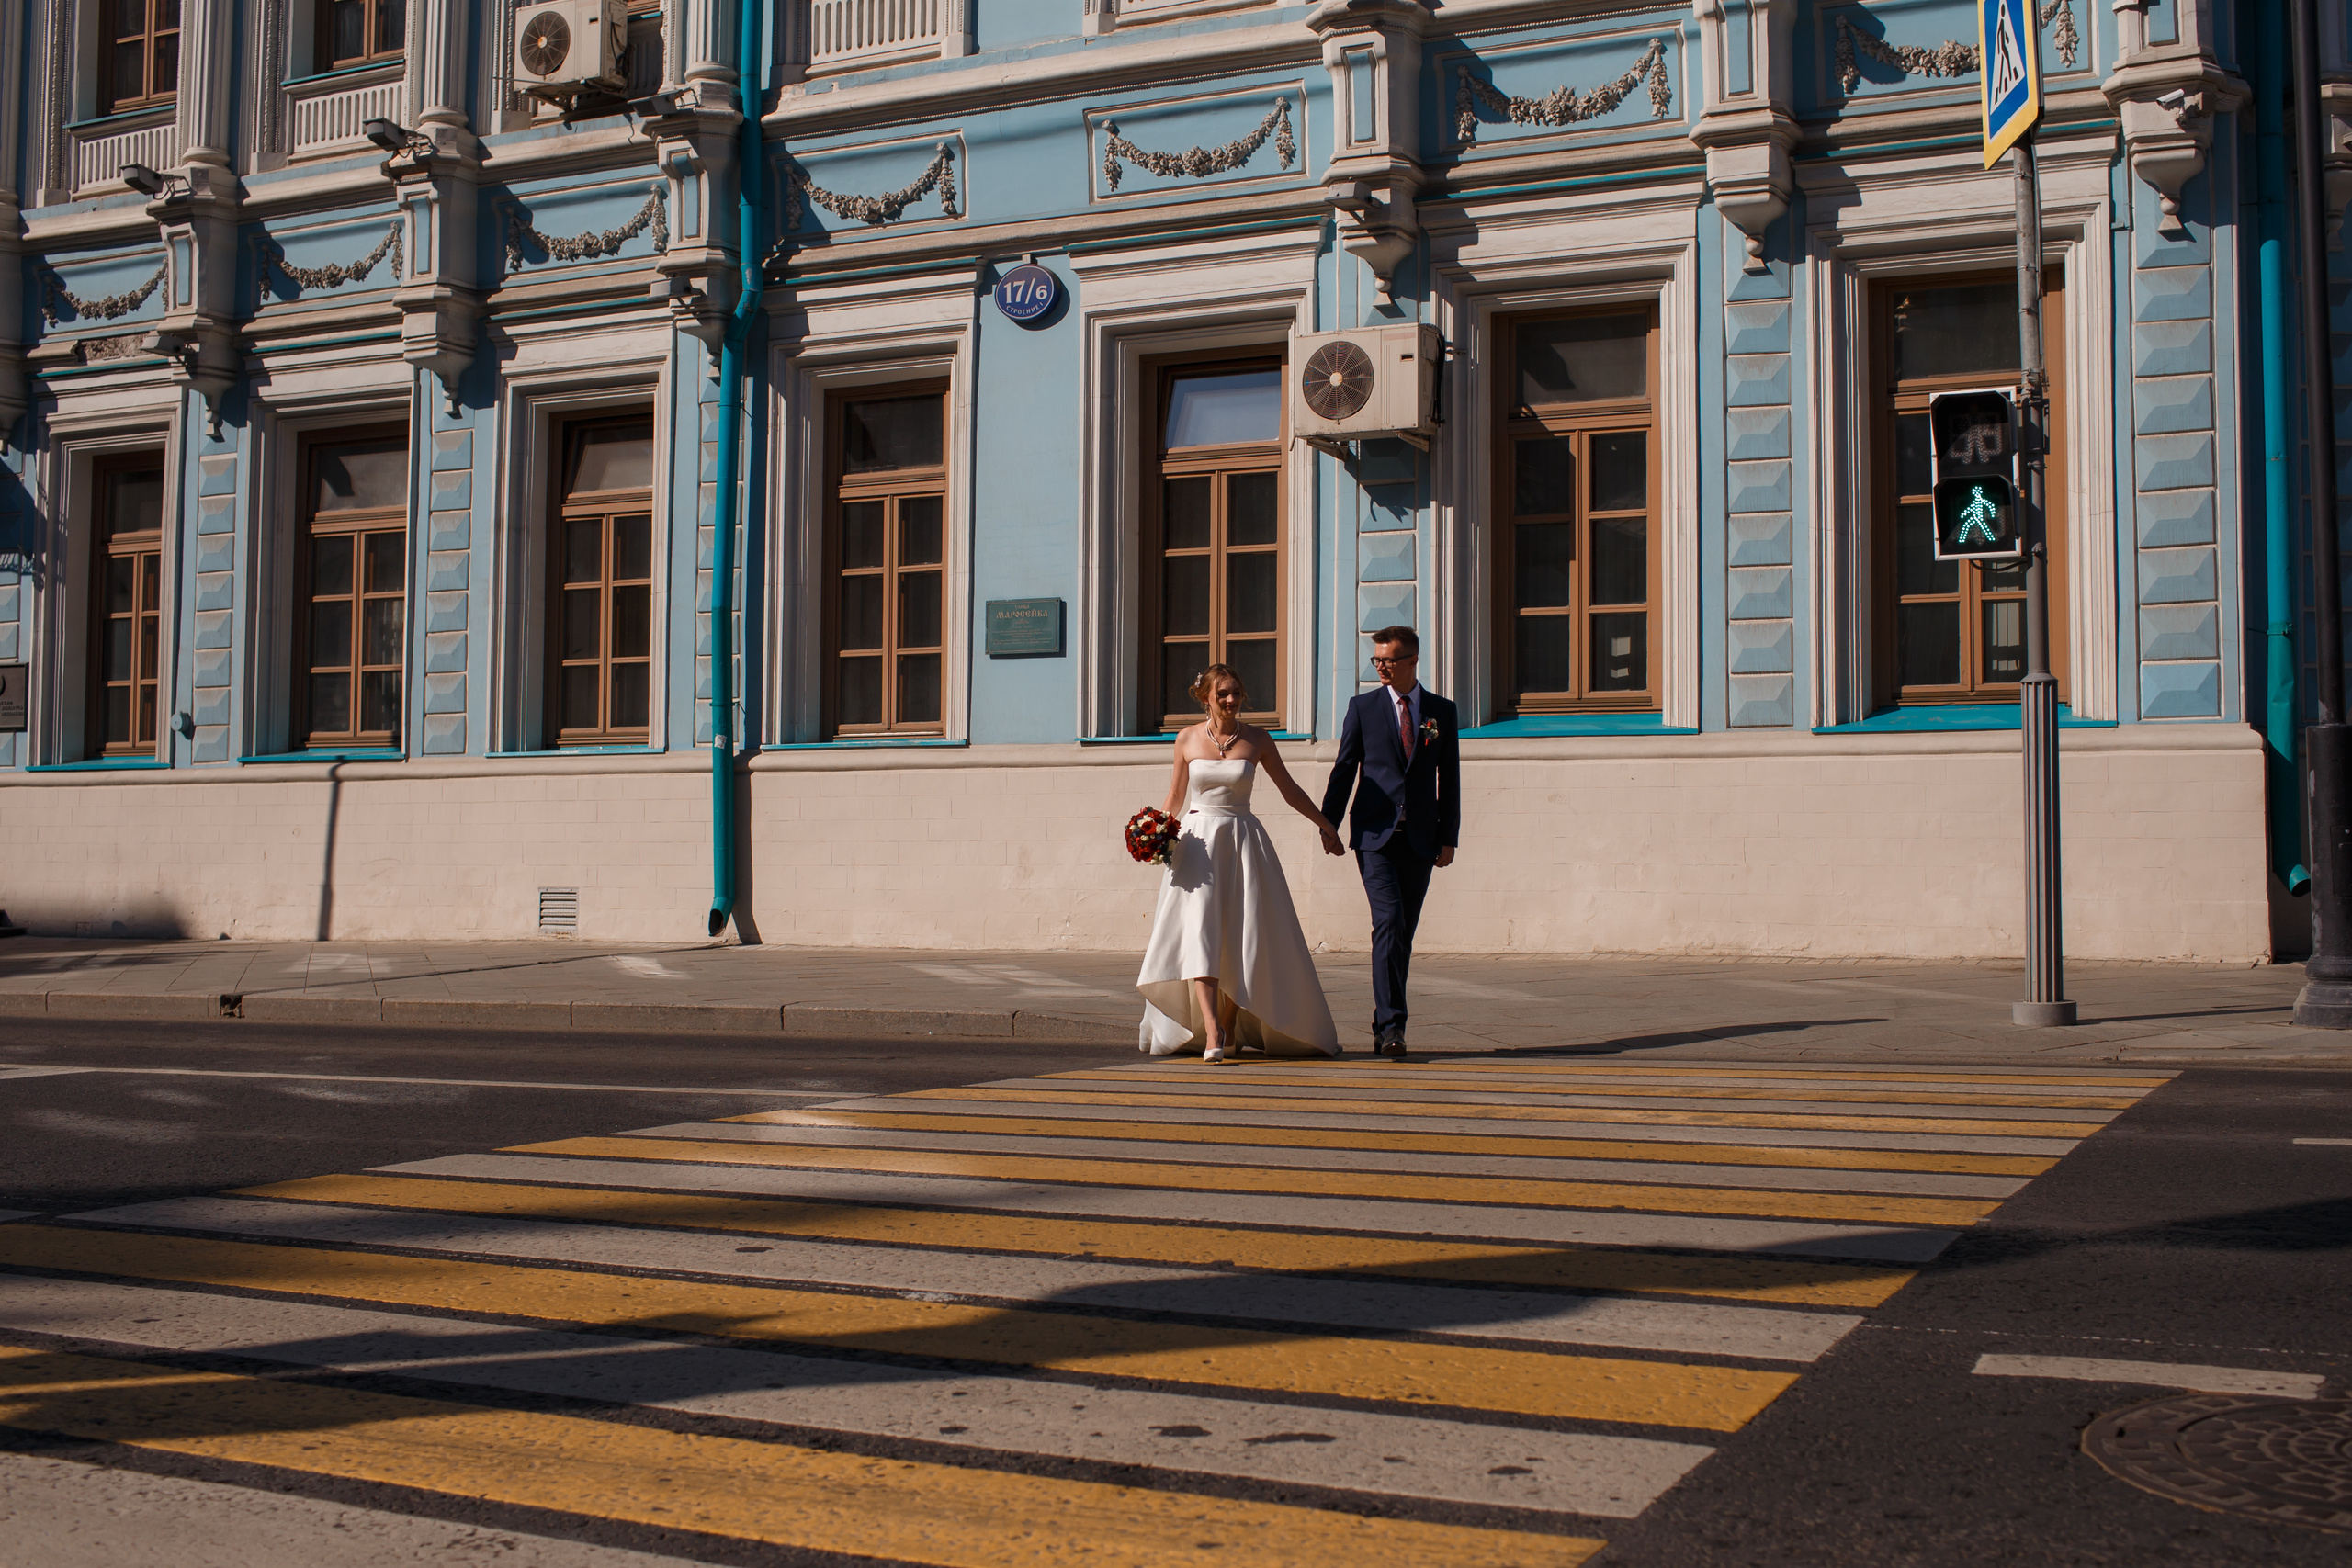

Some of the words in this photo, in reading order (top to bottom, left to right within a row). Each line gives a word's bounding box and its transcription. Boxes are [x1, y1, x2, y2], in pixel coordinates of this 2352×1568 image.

[1003, 277, 1047, 304] 17/6
[1006, 304, 1039, 315] СТРОЕНИЕ
[996, 609, 1048, 619] МАРОСЕЙКА
